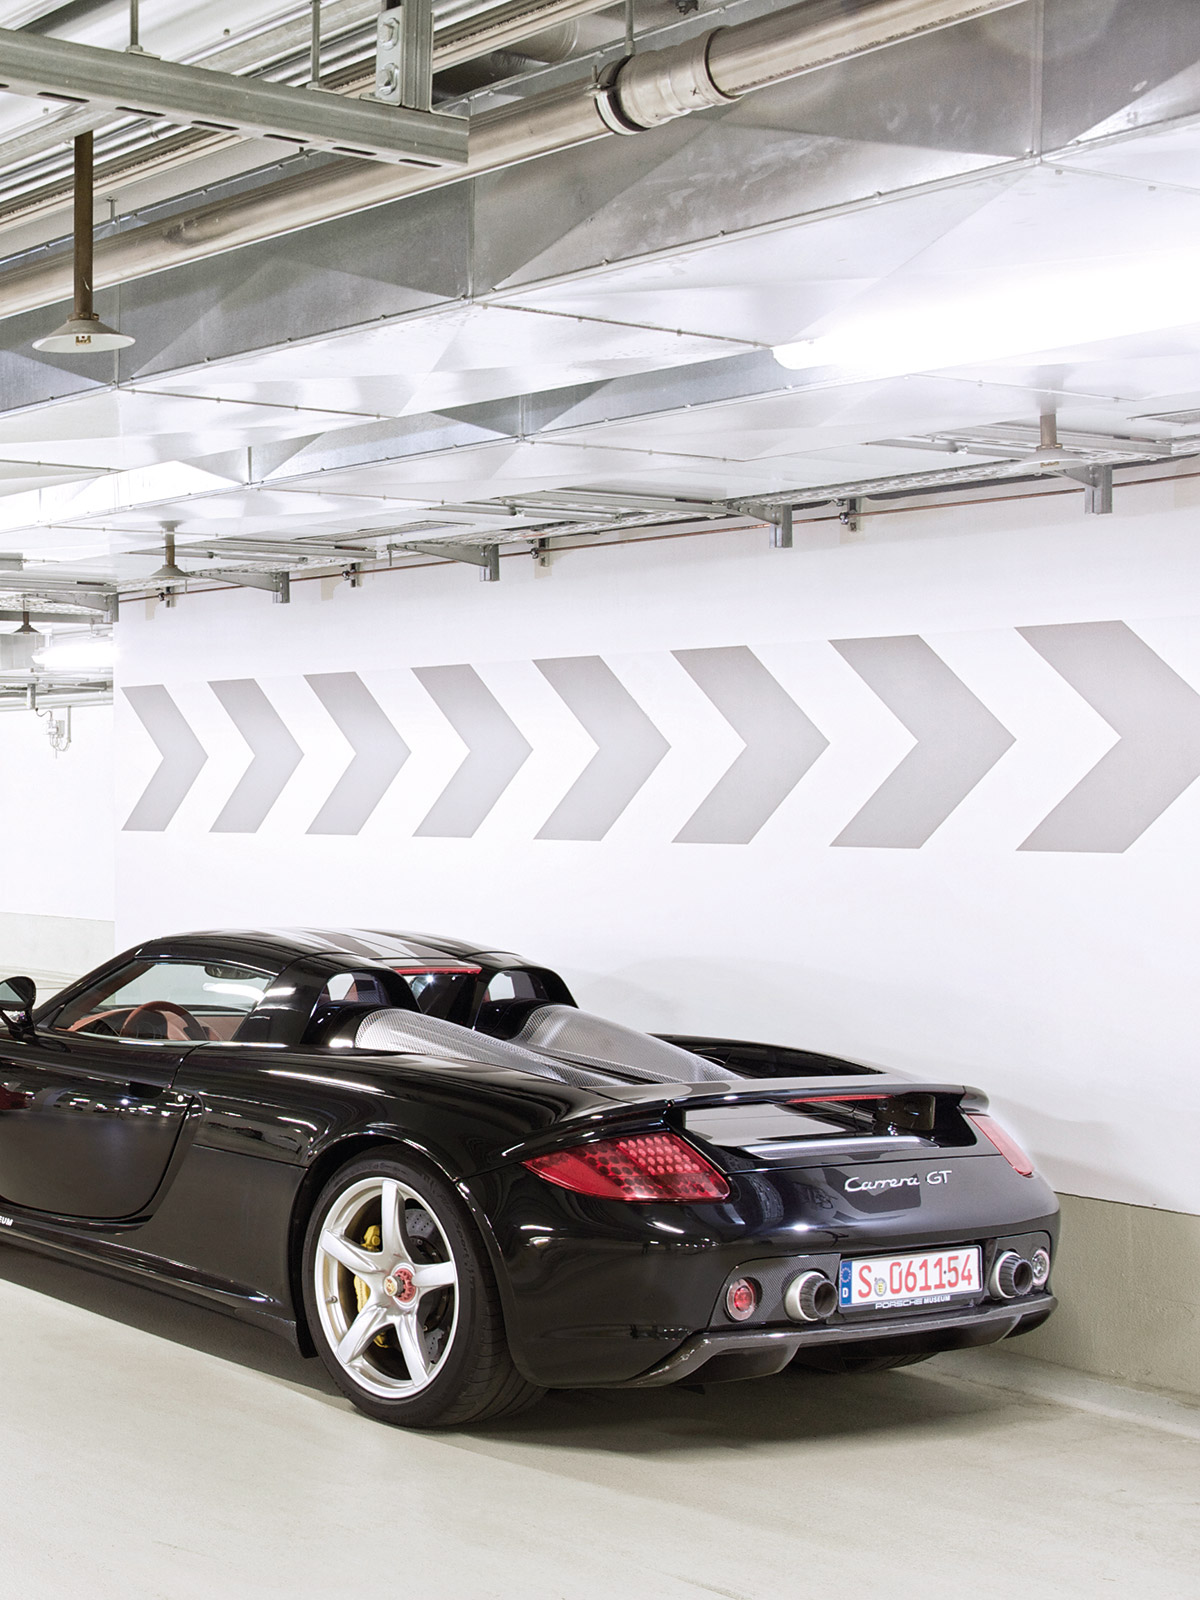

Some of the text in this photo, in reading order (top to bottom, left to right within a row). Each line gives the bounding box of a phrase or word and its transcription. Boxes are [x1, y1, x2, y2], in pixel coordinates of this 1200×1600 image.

[844, 1169, 953, 1193] Carrera GT
[842, 1254, 973, 1298] D S 061154
[875, 1294, 951, 1309] PORSCHE MUSEUM
